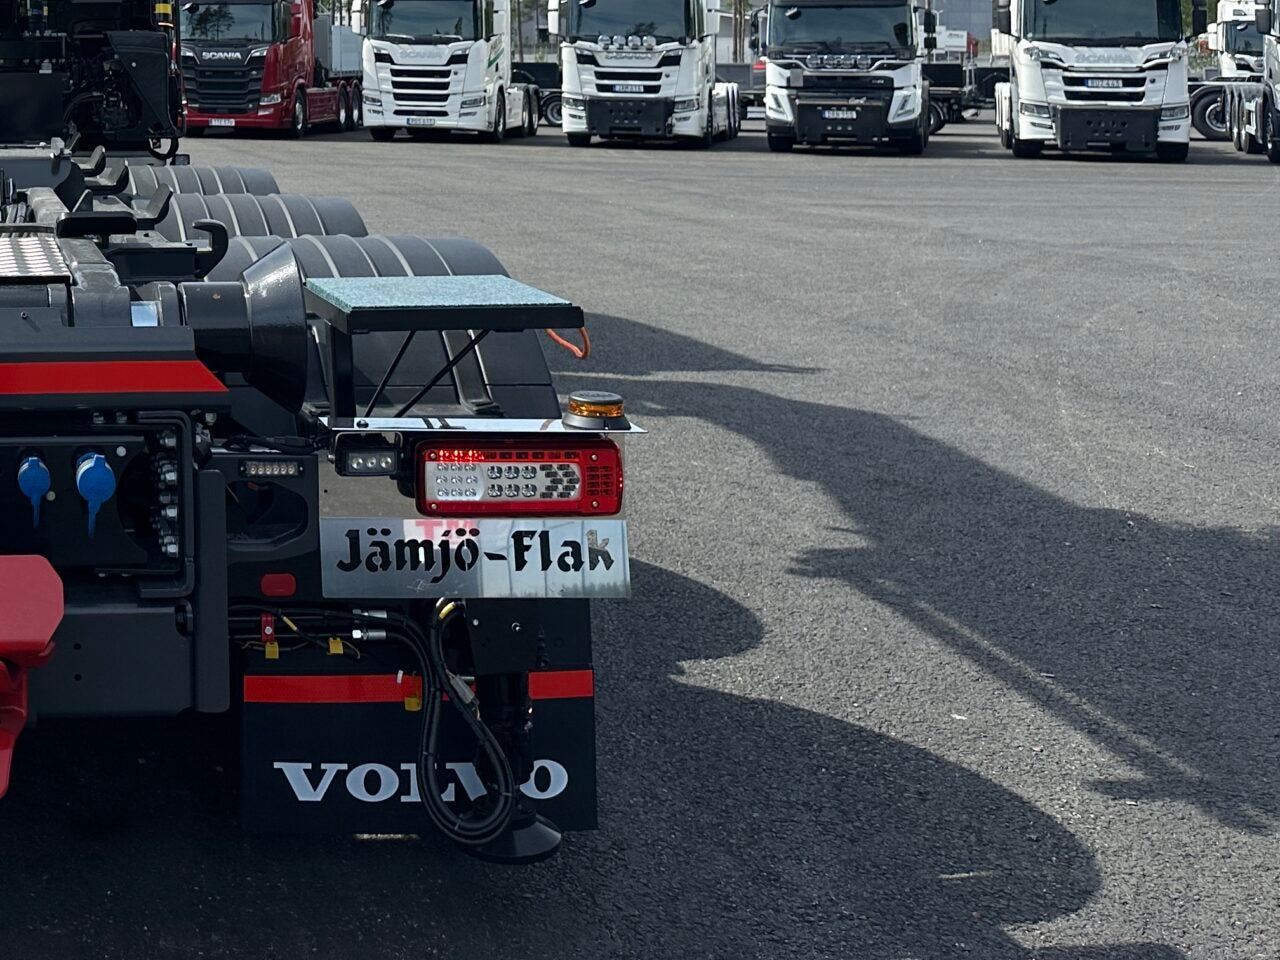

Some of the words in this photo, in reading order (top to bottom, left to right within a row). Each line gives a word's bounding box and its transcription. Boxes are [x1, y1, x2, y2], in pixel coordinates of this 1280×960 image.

[202, 51, 242, 60] SCANIA
[1074, 52, 1135, 64] SCANIA
[336, 527, 615, 584] Jämjö-Flak
